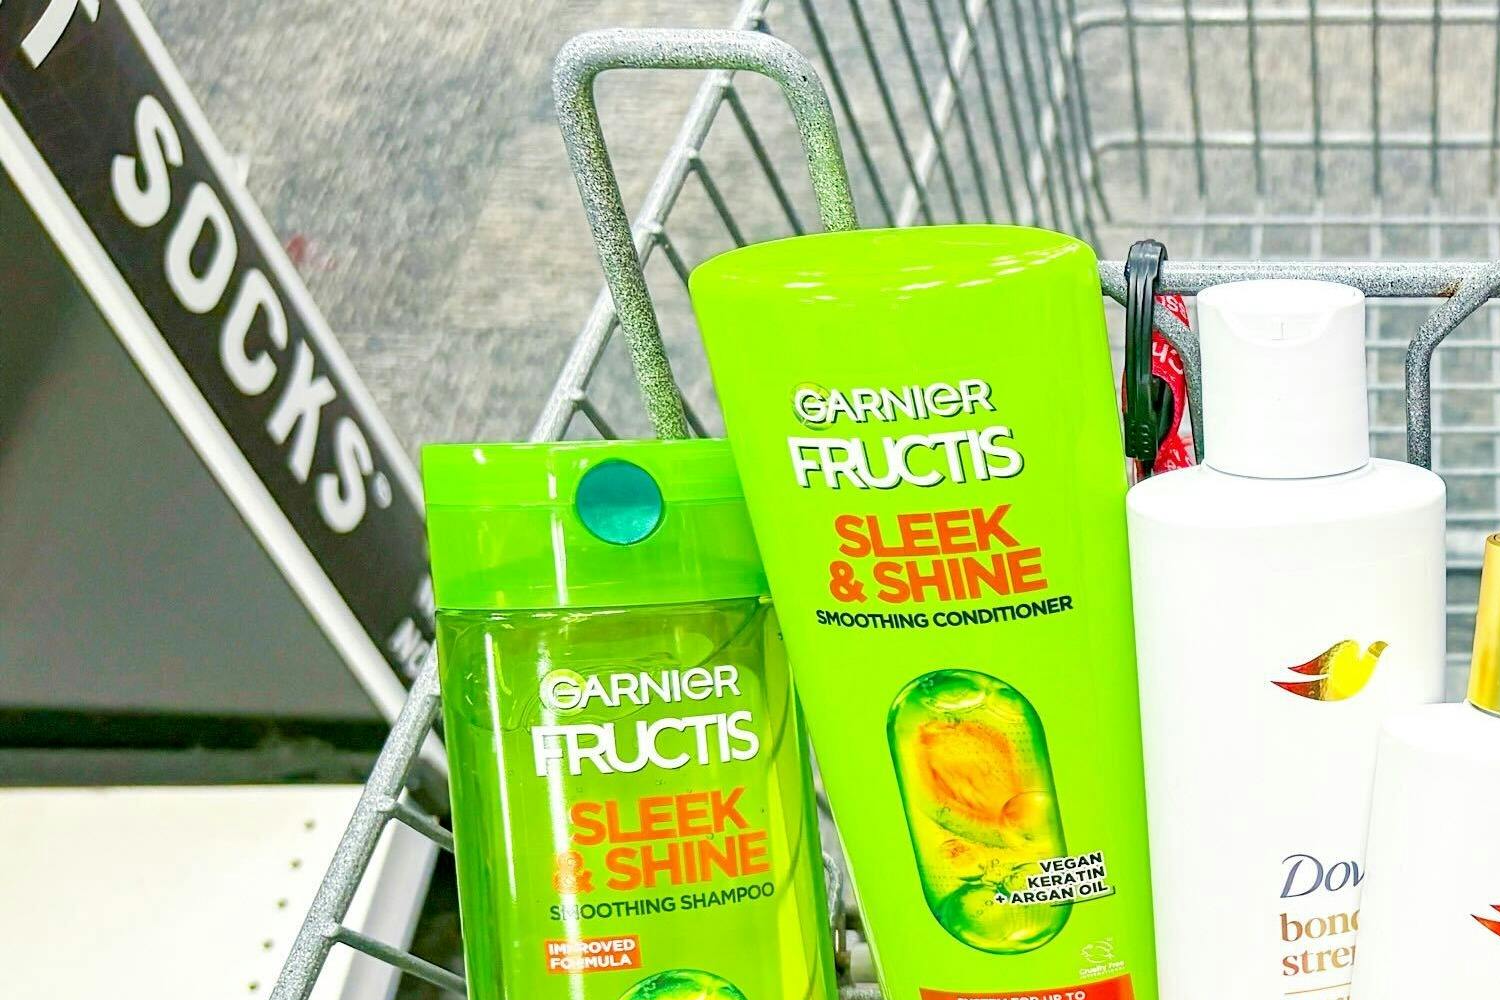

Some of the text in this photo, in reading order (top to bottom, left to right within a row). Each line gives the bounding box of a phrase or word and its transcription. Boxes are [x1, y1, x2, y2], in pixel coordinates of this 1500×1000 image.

[793, 378, 996, 424] GARNIER
[787, 426, 1025, 490] FRUCTIS
[834, 504, 1021, 558] SLEEK
[829, 546, 1049, 603] & SHINE
[815, 595, 1073, 630] SMOOTHING CONDITIONER
[549, 664, 741, 709] GARNIER
[531, 711, 760, 776] FRUCTIS
[570, 787, 751, 846] SLEEK
[552, 830, 771, 894] & SHINE
[1028, 866, 1106, 889] KERATIN
[1039, 852, 1103, 873] VEGAN
[1279, 853, 1366, 899] Dov
[681, 882, 775, 911] SHAMPOO
[1011, 881, 1109, 905] ARGAN OIL
[1281, 944, 1357, 977] stre
